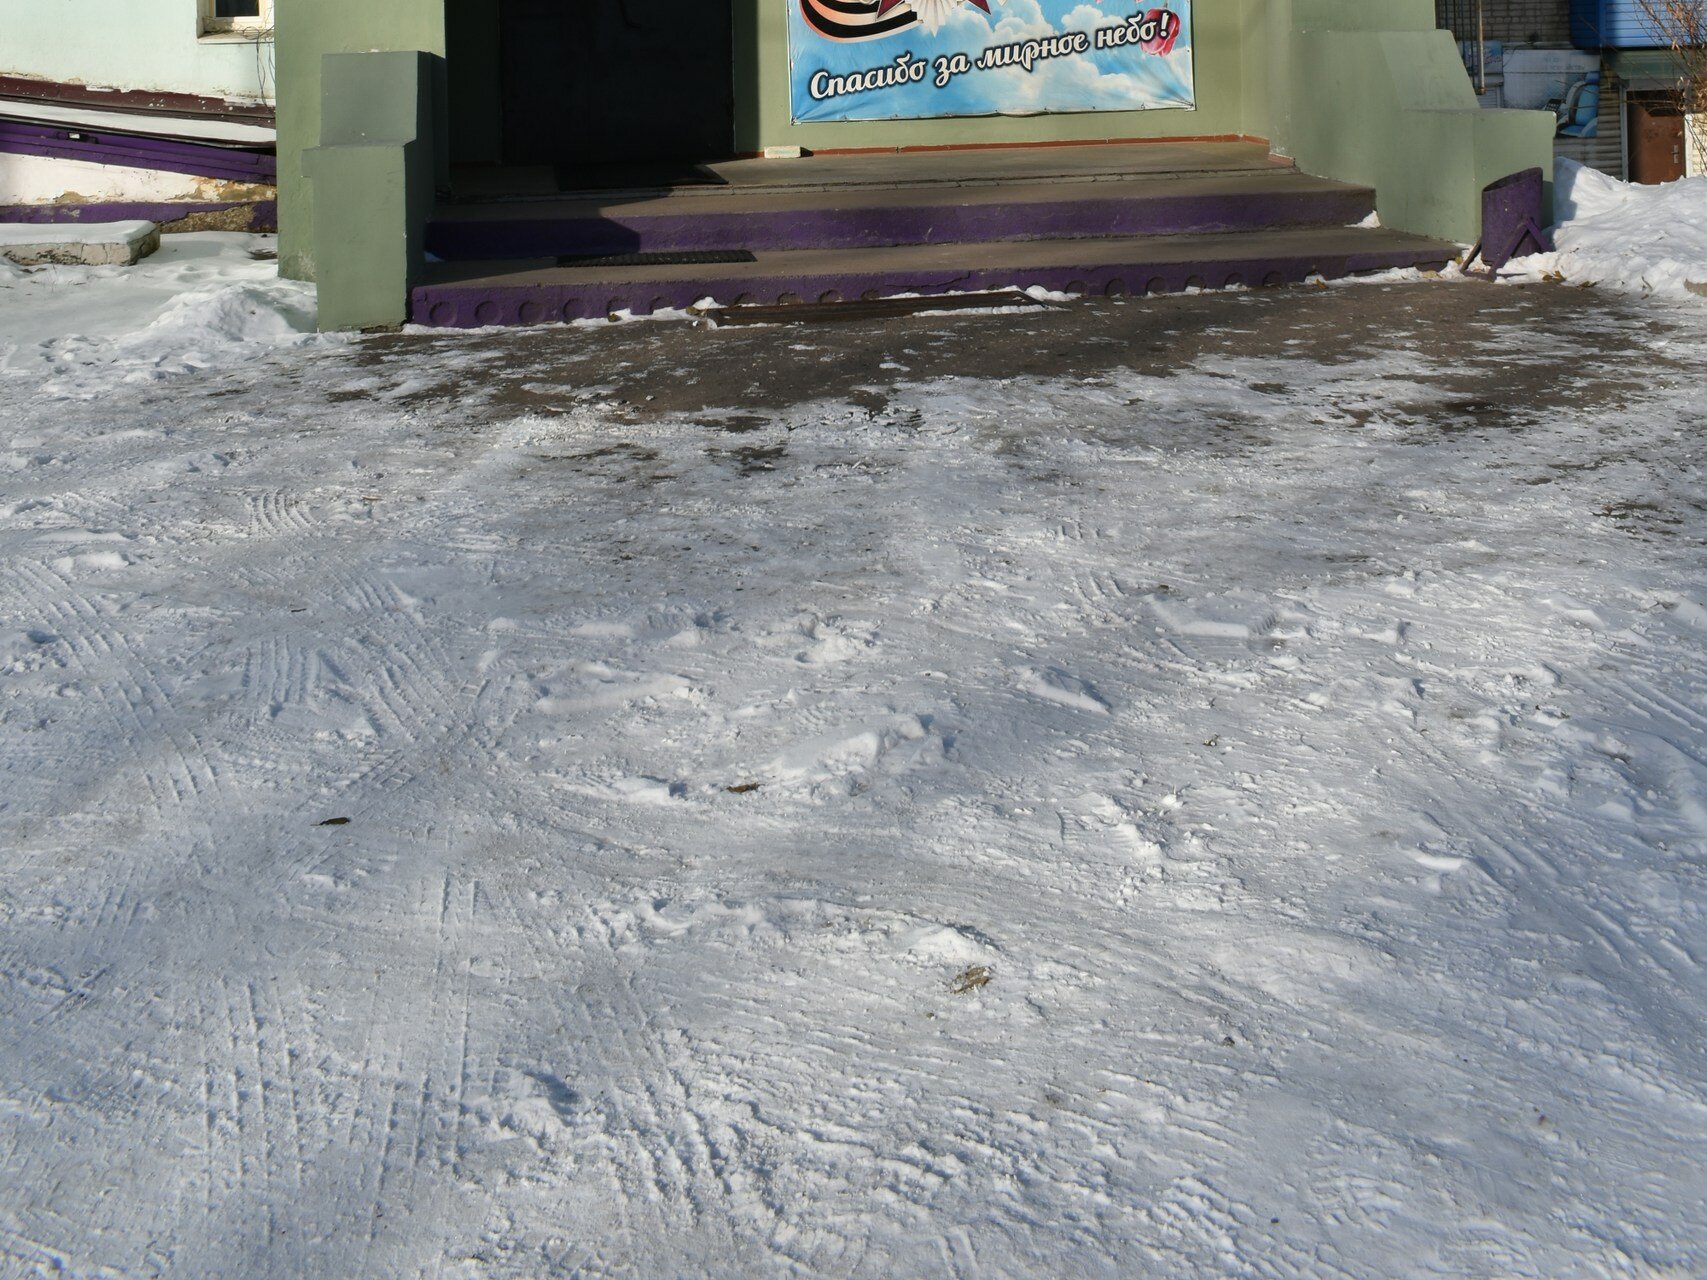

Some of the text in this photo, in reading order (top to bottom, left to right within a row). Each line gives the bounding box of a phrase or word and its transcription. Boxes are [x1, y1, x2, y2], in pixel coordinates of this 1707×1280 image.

[809, 12, 1171, 100] Спасибо за мирное небо!
